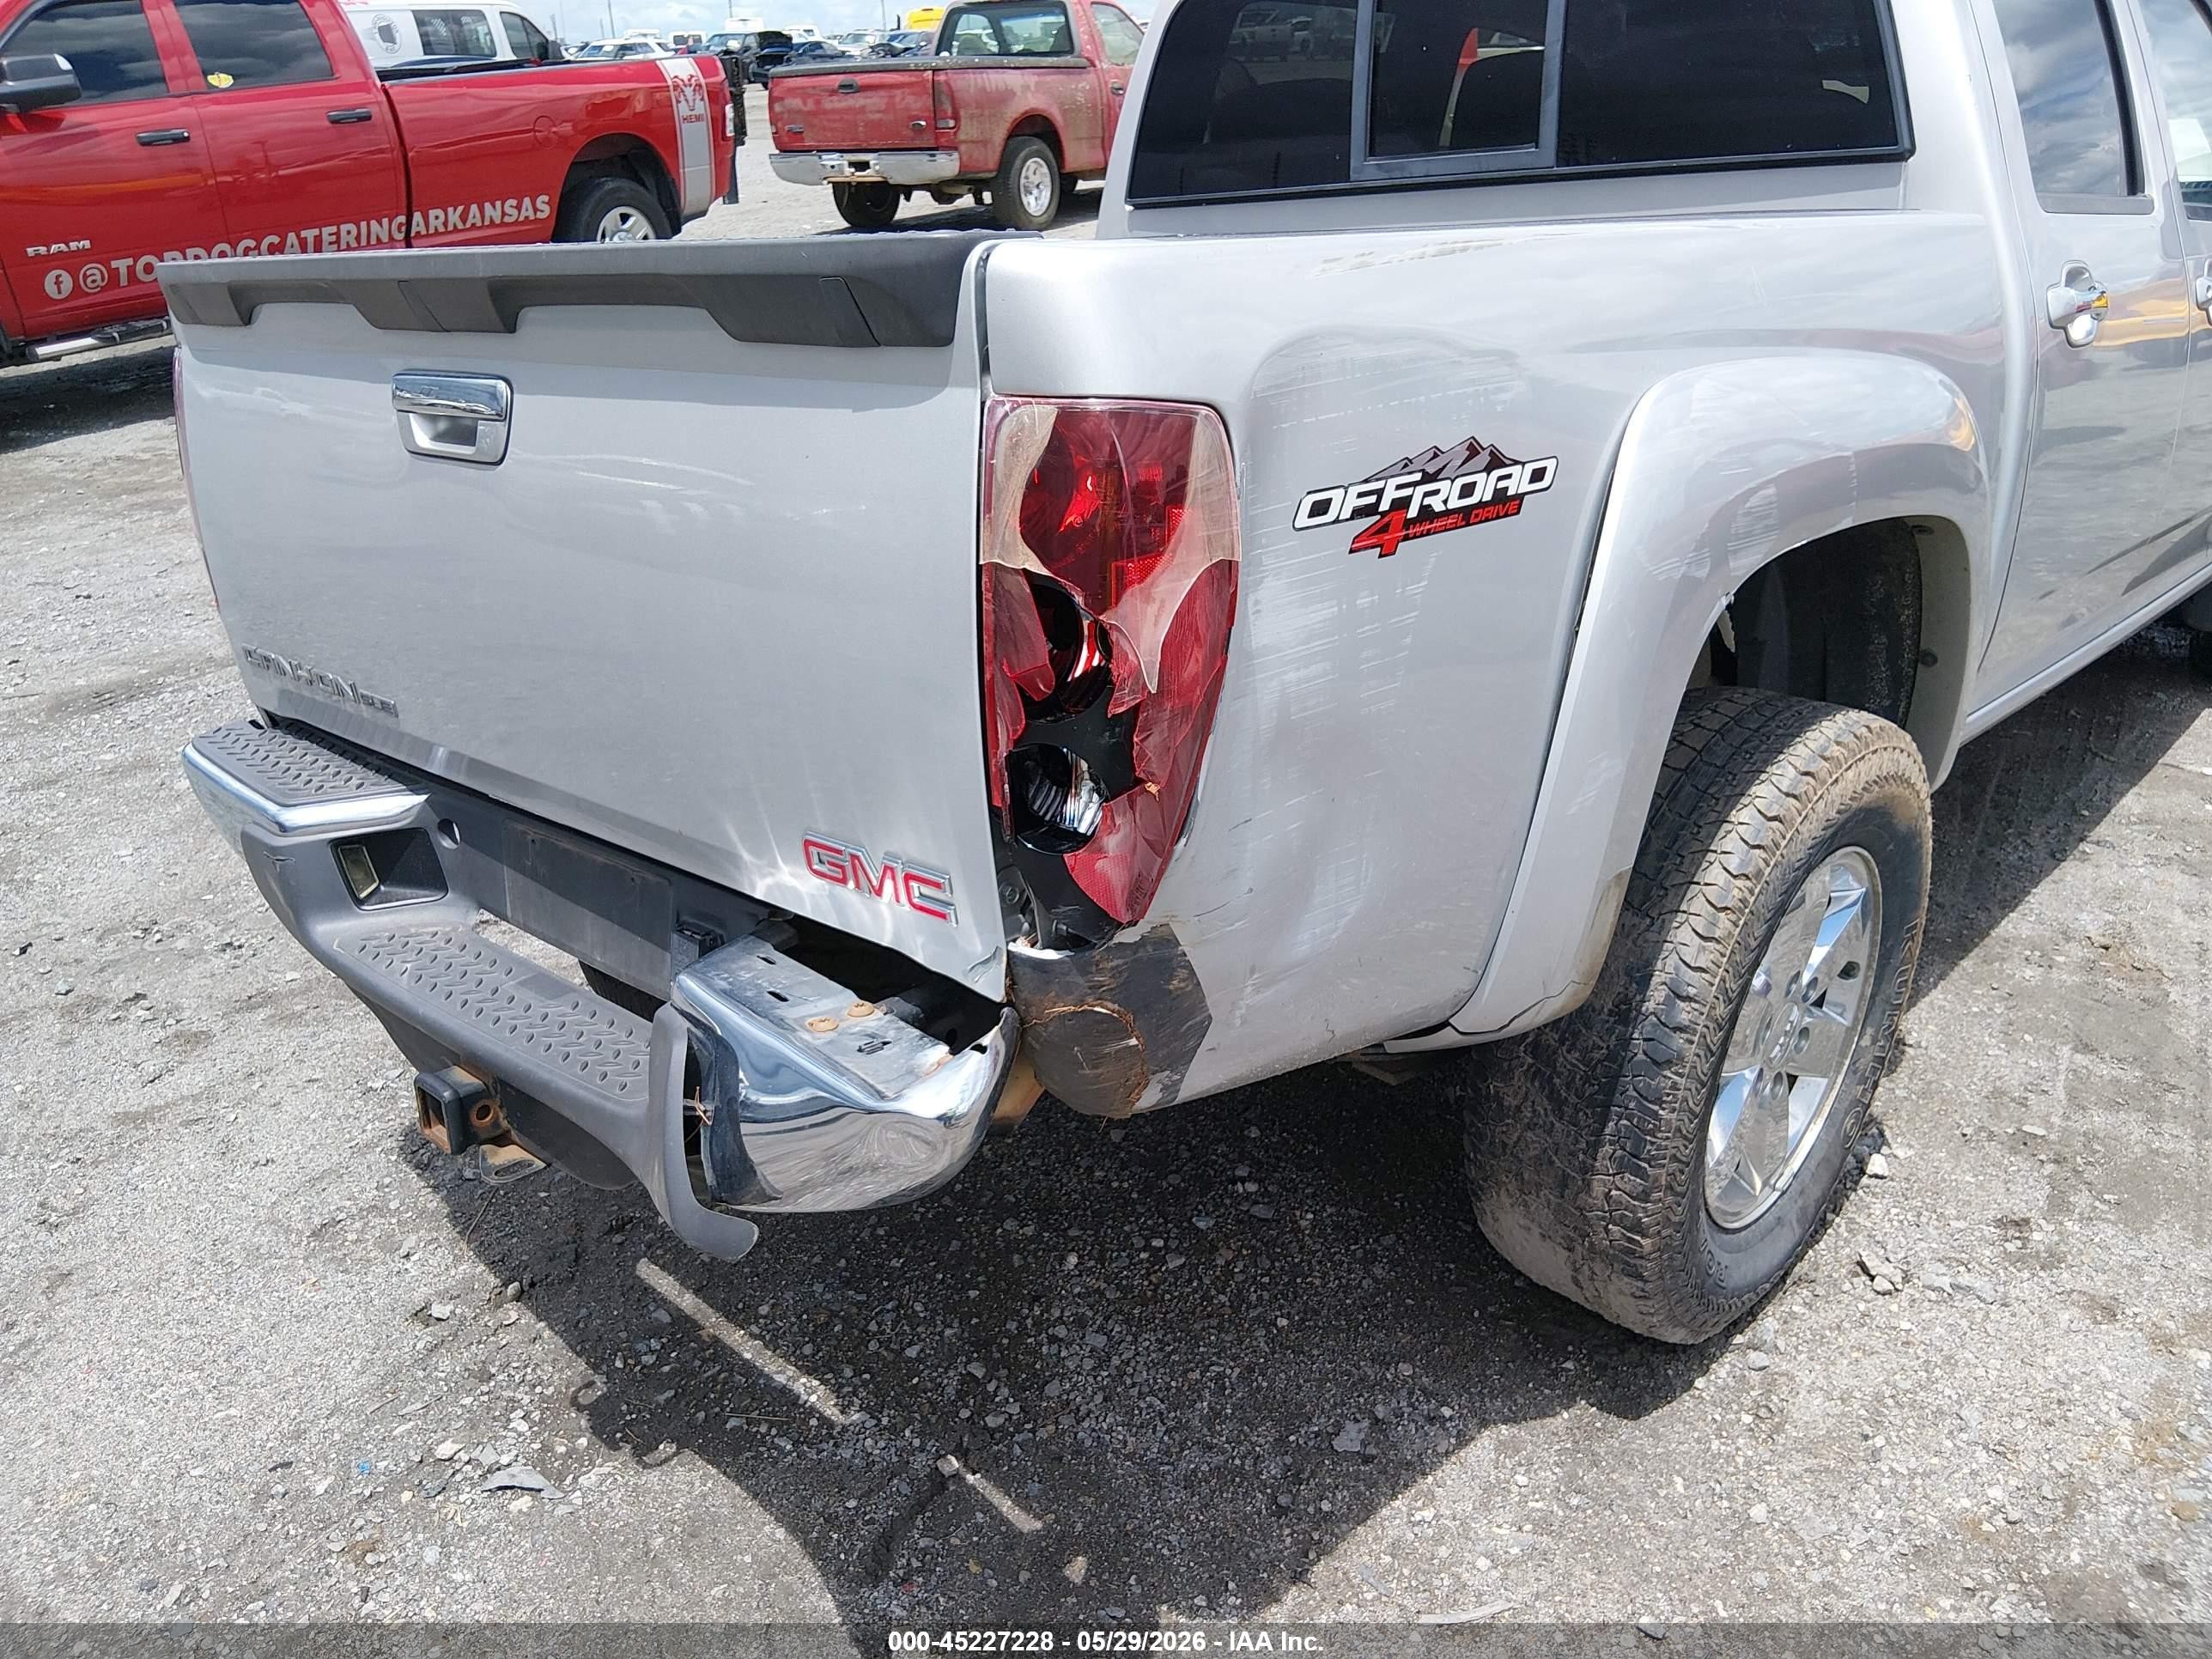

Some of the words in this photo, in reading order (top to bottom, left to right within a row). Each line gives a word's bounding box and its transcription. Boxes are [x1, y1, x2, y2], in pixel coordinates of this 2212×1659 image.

[26, 240, 91, 257] RAM
[1293, 456, 1558, 530] OFFROAD
[1349, 508, 1407, 557] 4
[1408, 514, 1466, 538] WHEEL
[1470, 501, 1520, 523] DRIVE
[802, 830, 959, 927] GMC
[1841, 918, 1920, 1148] KUMHO
